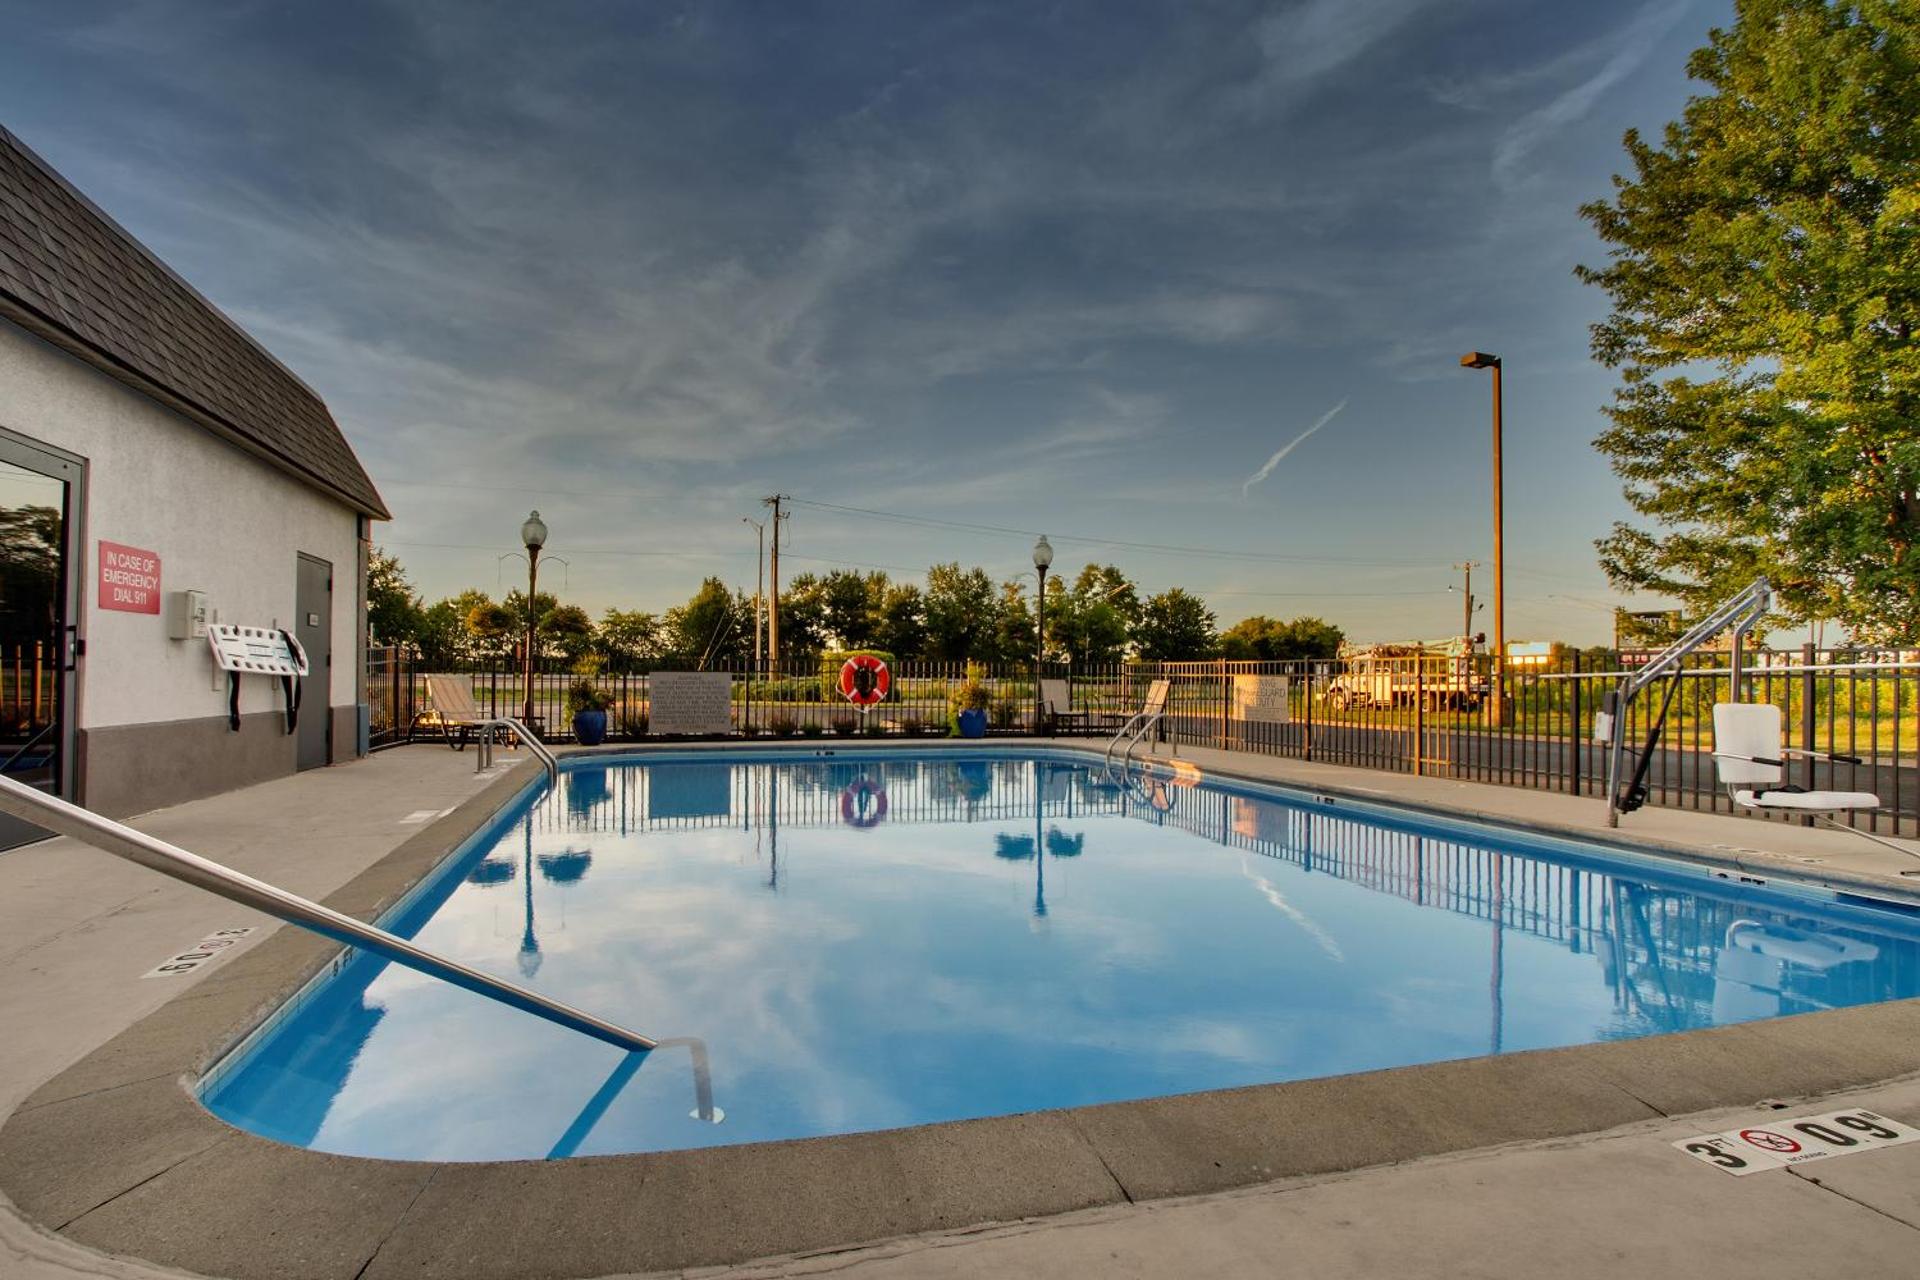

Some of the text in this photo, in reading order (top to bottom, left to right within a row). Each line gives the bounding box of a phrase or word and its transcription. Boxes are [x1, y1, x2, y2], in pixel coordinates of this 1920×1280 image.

[107, 551, 155, 573] IN CASE OF
[104, 568, 158, 590] EMERGENCY
[114, 587, 147, 605] DIAL 911
[1686, 1142, 1748, 1168] 3
